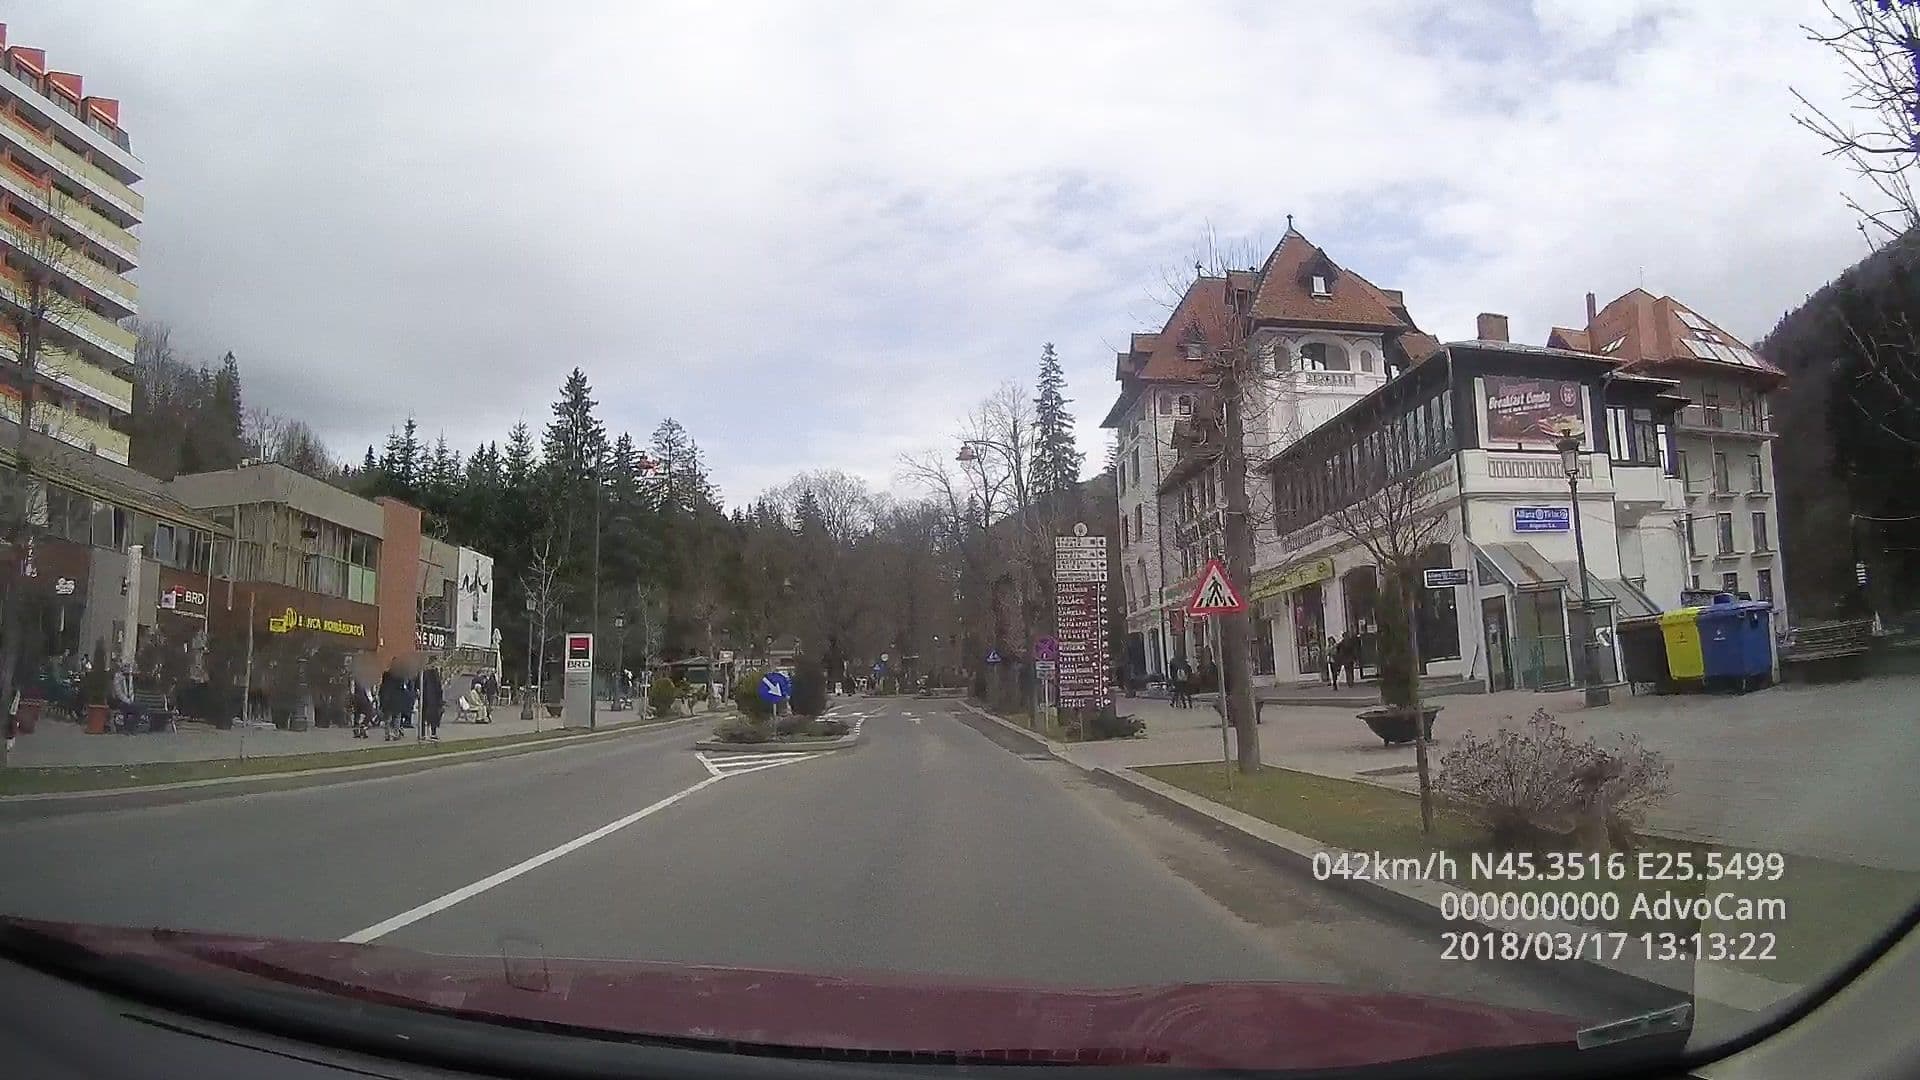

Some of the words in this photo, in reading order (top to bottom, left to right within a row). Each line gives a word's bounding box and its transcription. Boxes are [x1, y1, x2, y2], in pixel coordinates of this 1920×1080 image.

[185, 591, 204, 605] BRD
[429, 633, 445, 647] PUB
[567, 660, 591, 669] BRD
